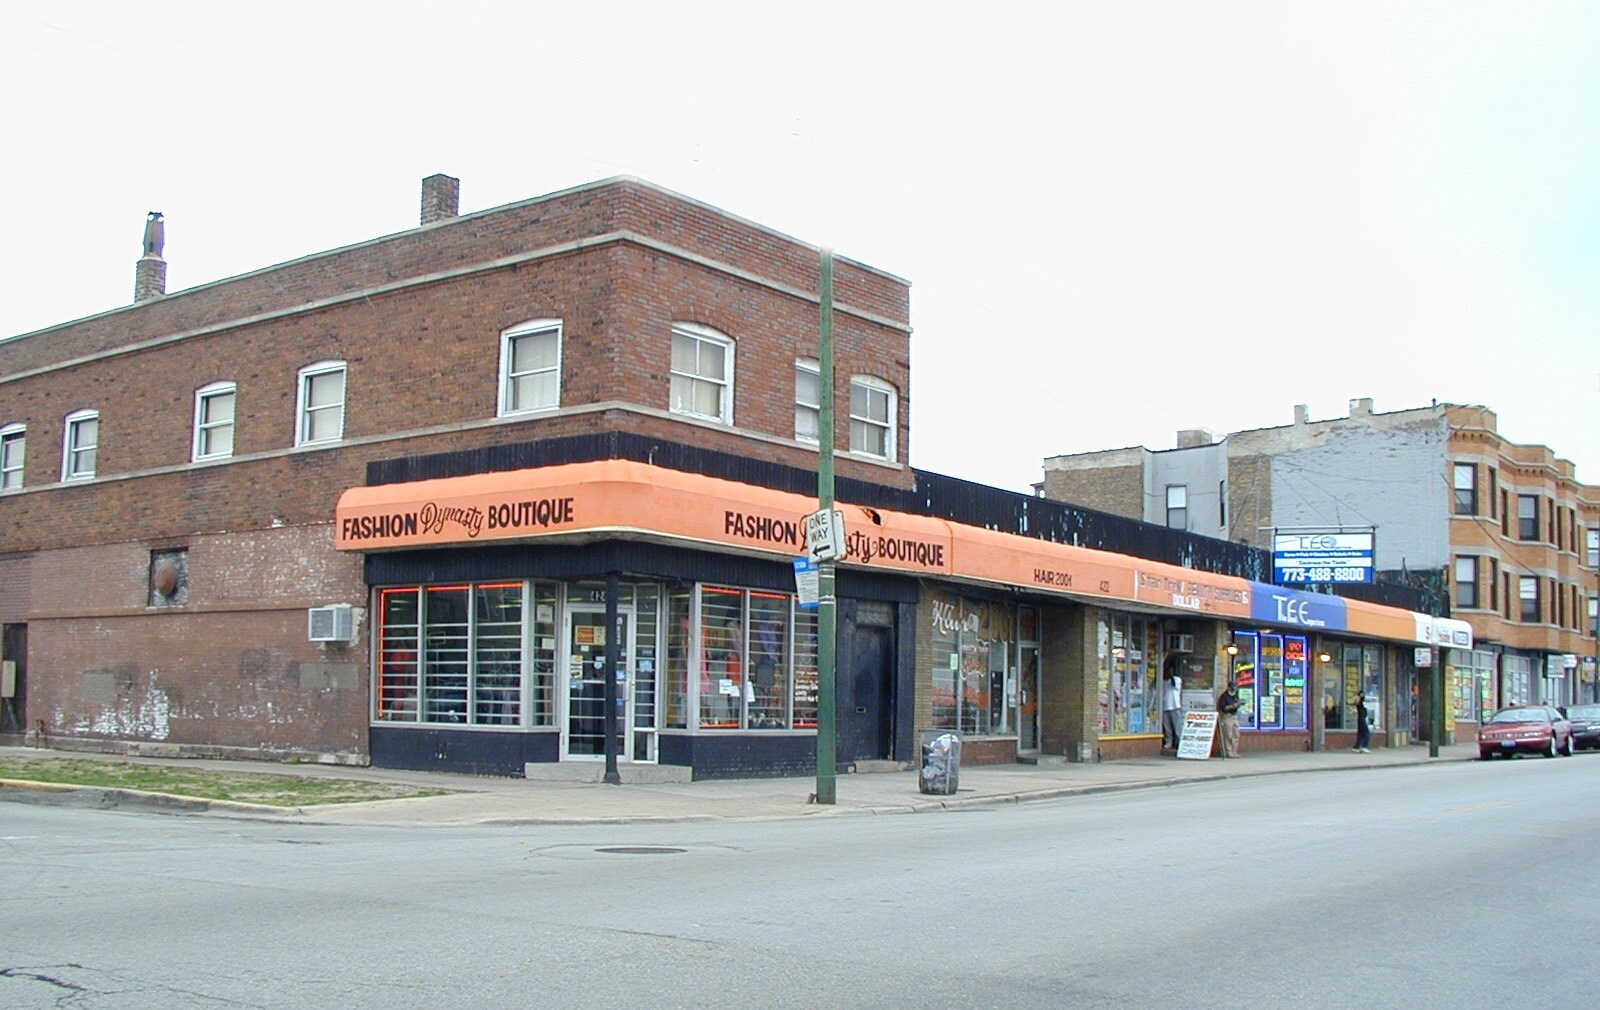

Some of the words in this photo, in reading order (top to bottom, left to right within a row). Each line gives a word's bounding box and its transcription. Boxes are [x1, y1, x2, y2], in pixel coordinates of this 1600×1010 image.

[342, 512, 417, 541] FASHION
[420, 502, 485, 538] Dynasty
[488, 497, 574, 529] BOUTIQUE
[810, 512, 828, 530] ONE
[724, 511, 797, 546] FASHION
[879, 537, 944, 567] BOUTIQUE
[810, 527, 829, 544] WAY
[1033, 568, 1055, 585] HAIR
[1055, 572, 1073, 587] 2001
[1282, 567, 1365, 582] 773-488-8800
